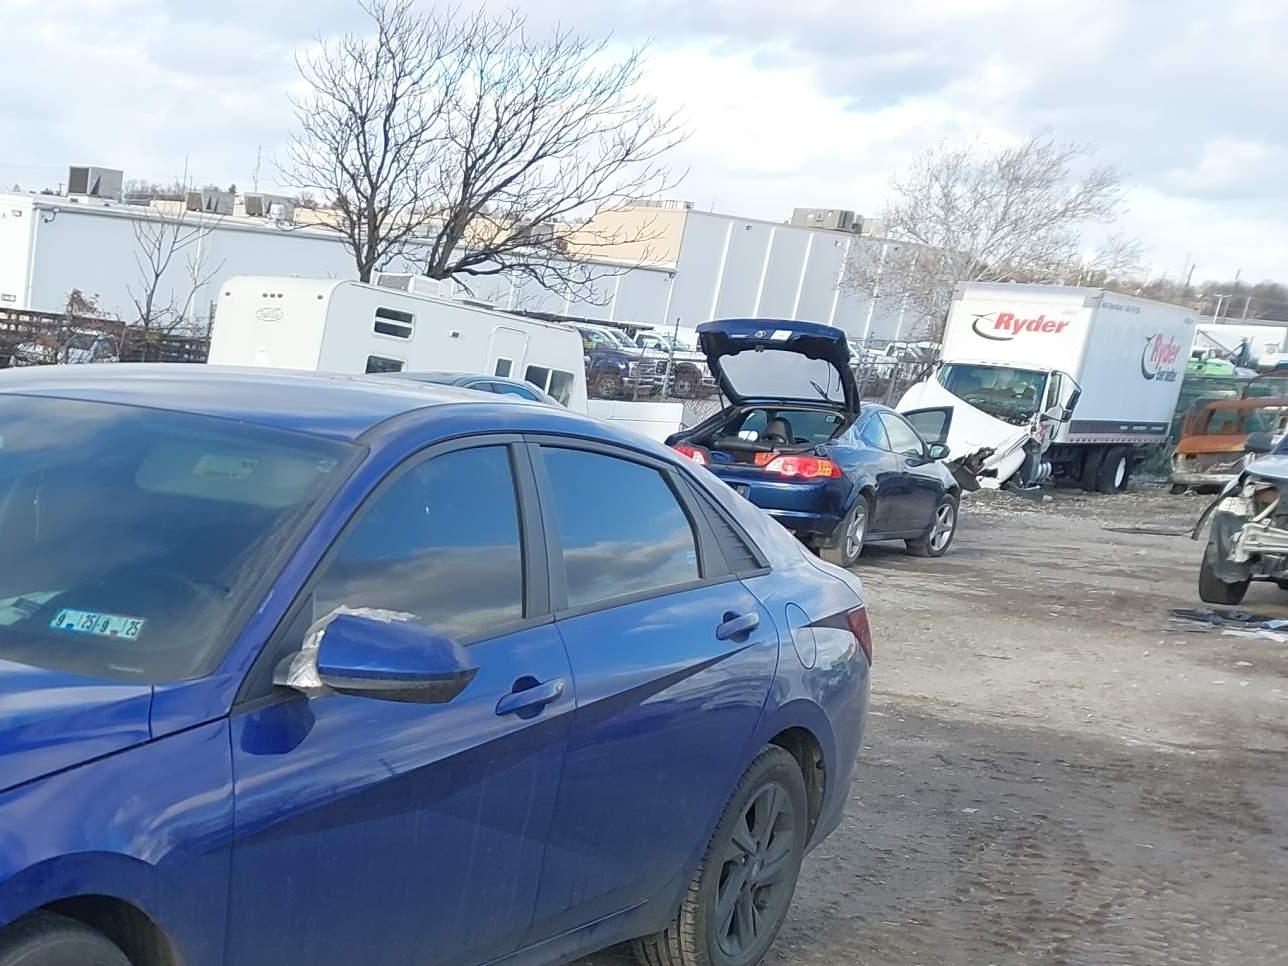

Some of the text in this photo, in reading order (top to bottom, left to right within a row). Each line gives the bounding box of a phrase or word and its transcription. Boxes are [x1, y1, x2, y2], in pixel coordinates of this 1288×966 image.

[993, 312, 1070, 335] Ryder
[56, 614, 97, 629] 9 25
[126, 621, 140, 636] 25
